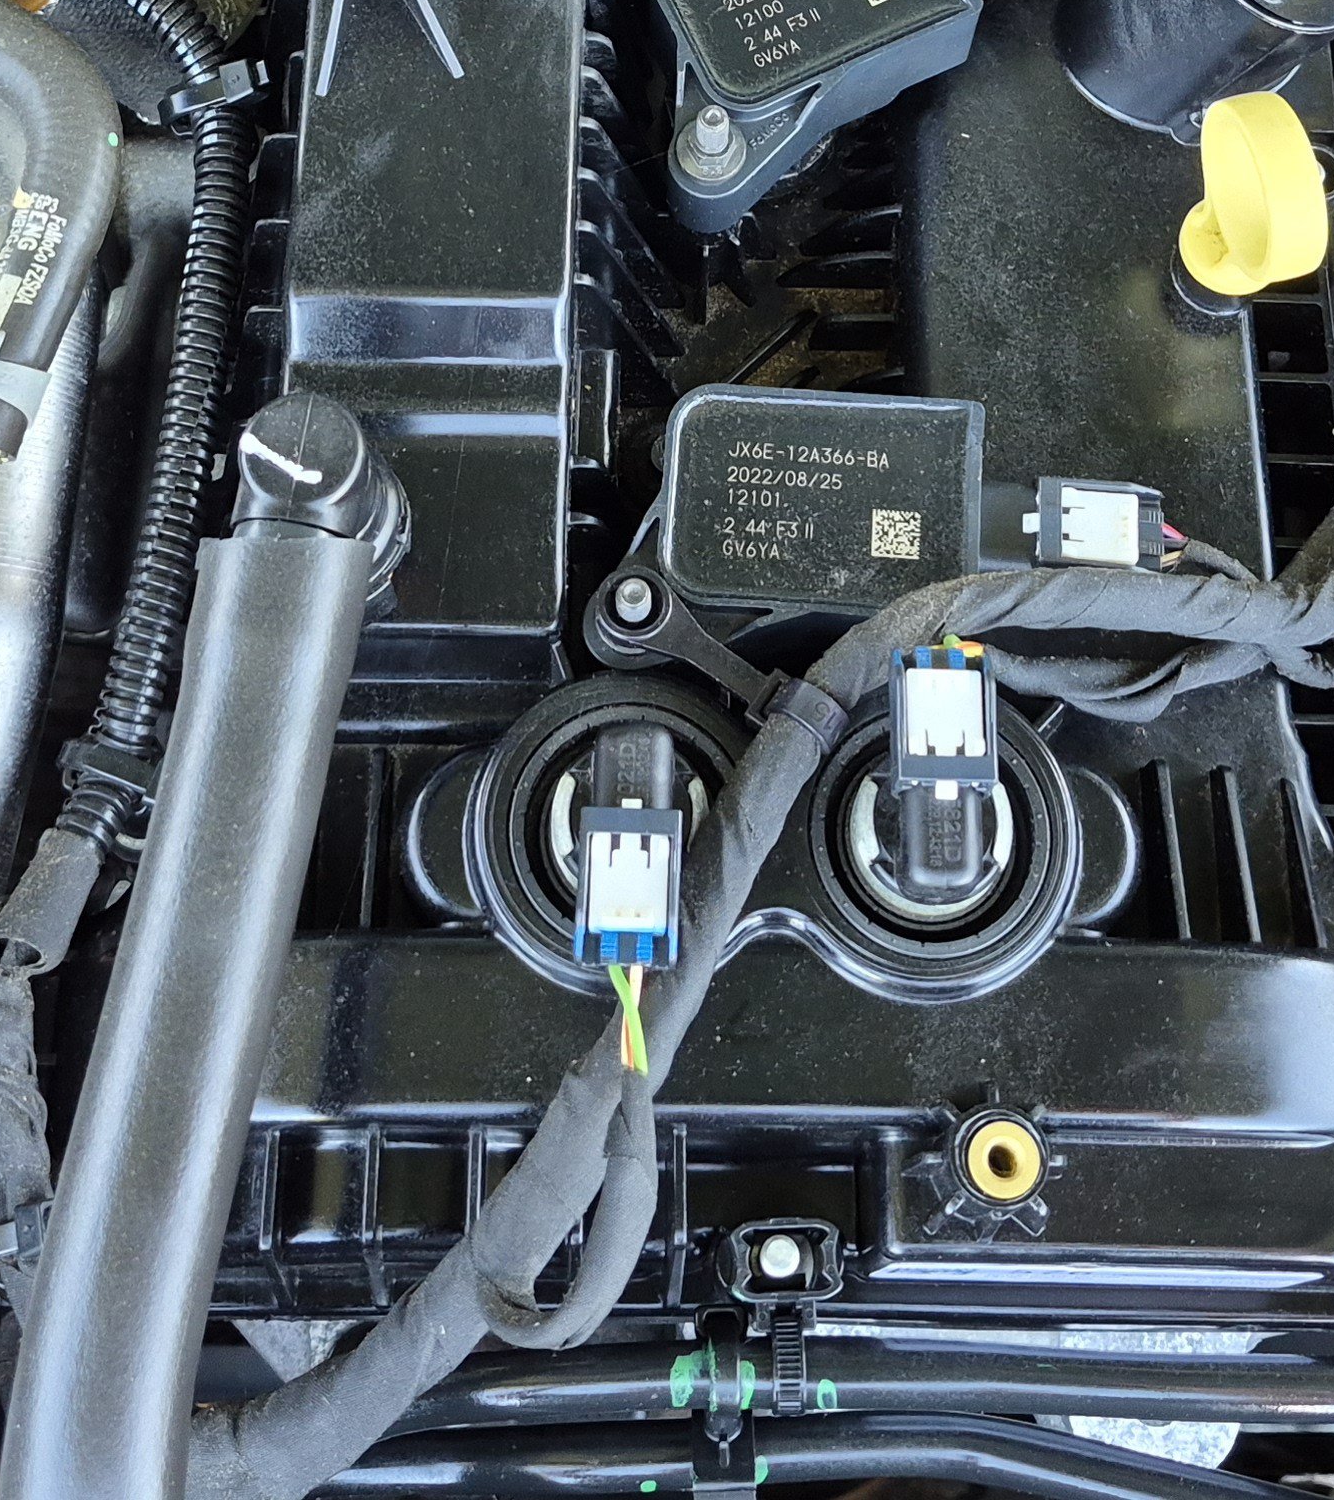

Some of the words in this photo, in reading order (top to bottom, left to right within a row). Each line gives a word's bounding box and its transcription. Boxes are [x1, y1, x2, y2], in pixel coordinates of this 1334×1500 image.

[734, 0, 784, 31] 12100
[744, 36, 757, 52] 2
[763, 24, 782, 43] 44
[785, 13, 808, 34] F3
[753, 38, 801, 68] GV6YA
[17, 209, 49, 251] ENG
[33, 214, 68, 263] FoMoCo
[728, 441, 890, 470] JX6E-12A366-BA
[727, 466, 843, 490] 2022/08/25
[728, 488, 780, 507] 12101
[723, 516, 735, 535] 2
[745, 518, 766, 536] 44
[722, 538, 780, 560] GV6YA
